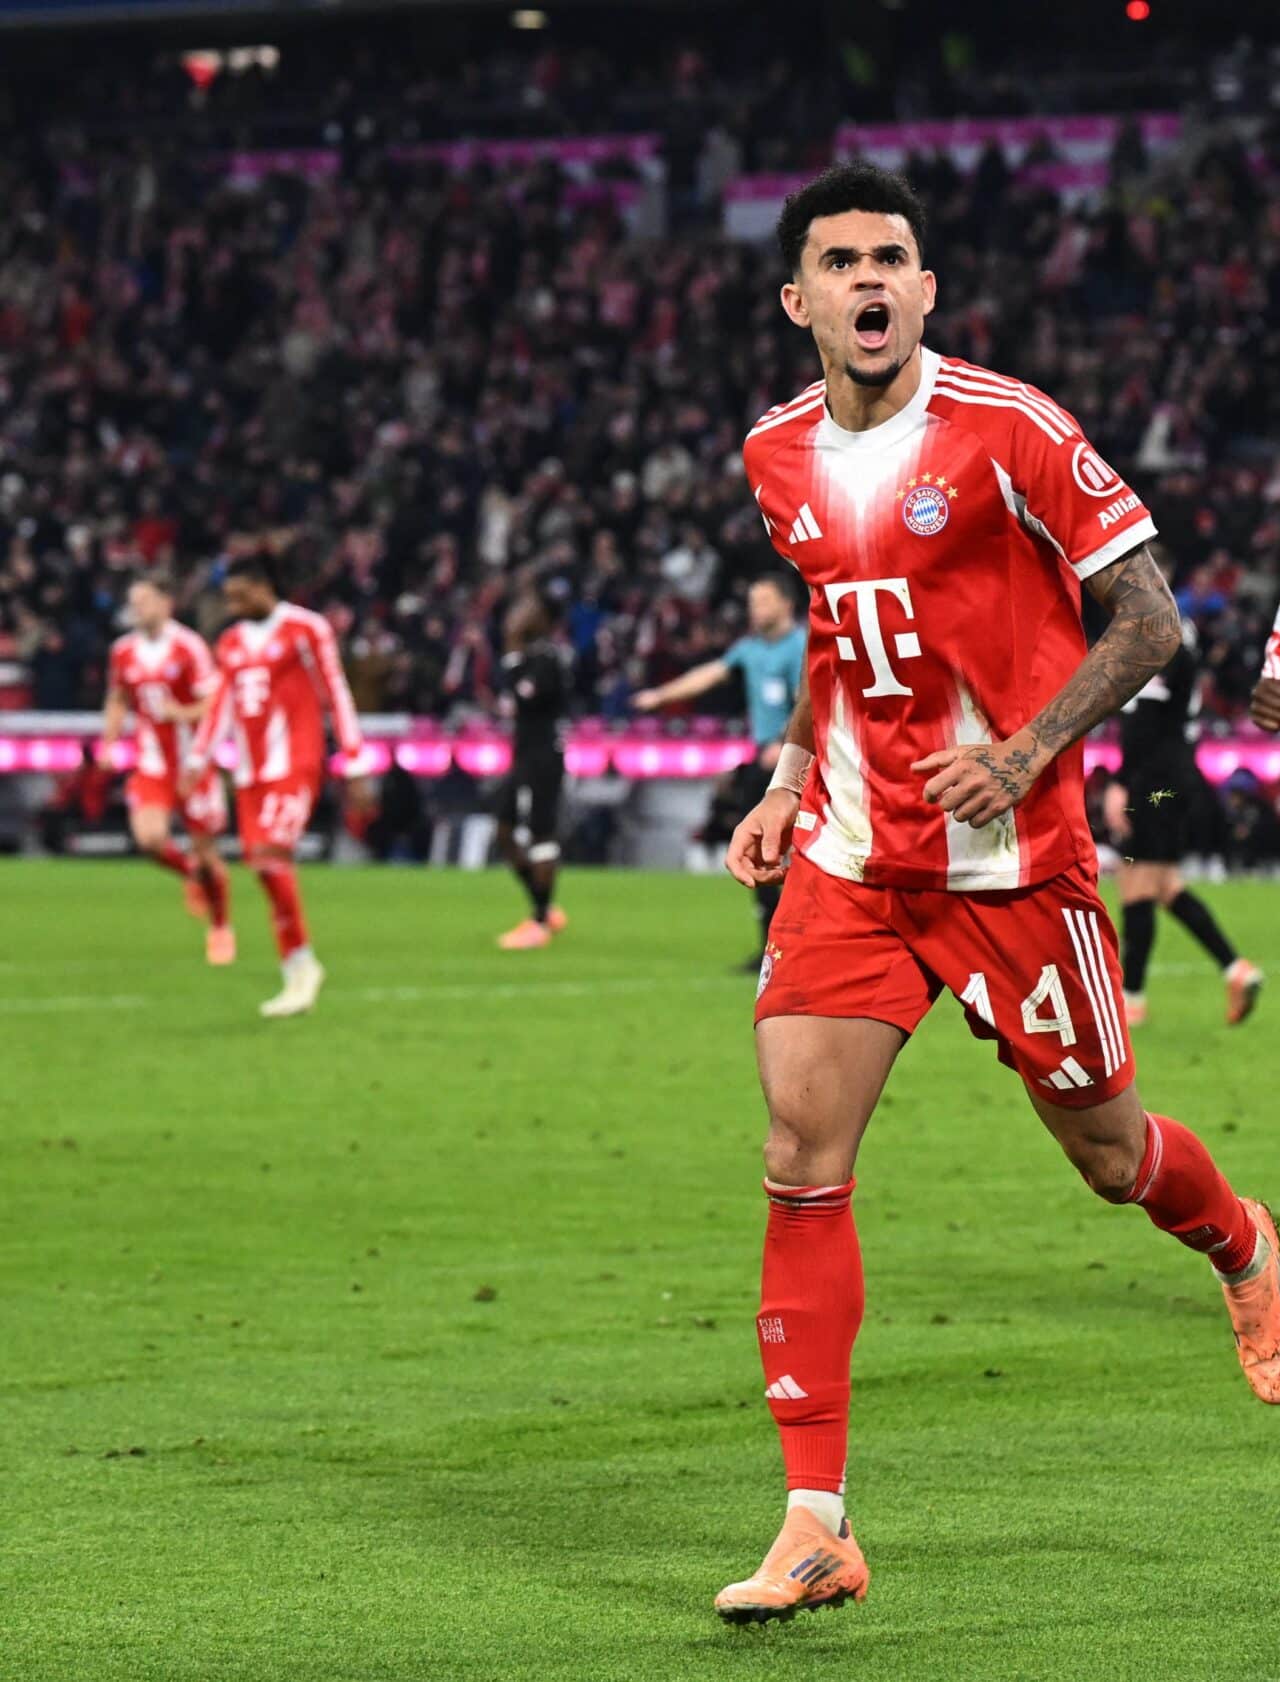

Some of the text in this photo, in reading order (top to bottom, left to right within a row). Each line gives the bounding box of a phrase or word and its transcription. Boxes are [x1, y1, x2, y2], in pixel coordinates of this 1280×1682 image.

[916, 489, 945, 507] BAYERN
[823, 577, 922, 698] T
[960, 963, 1077, 1047] 14
